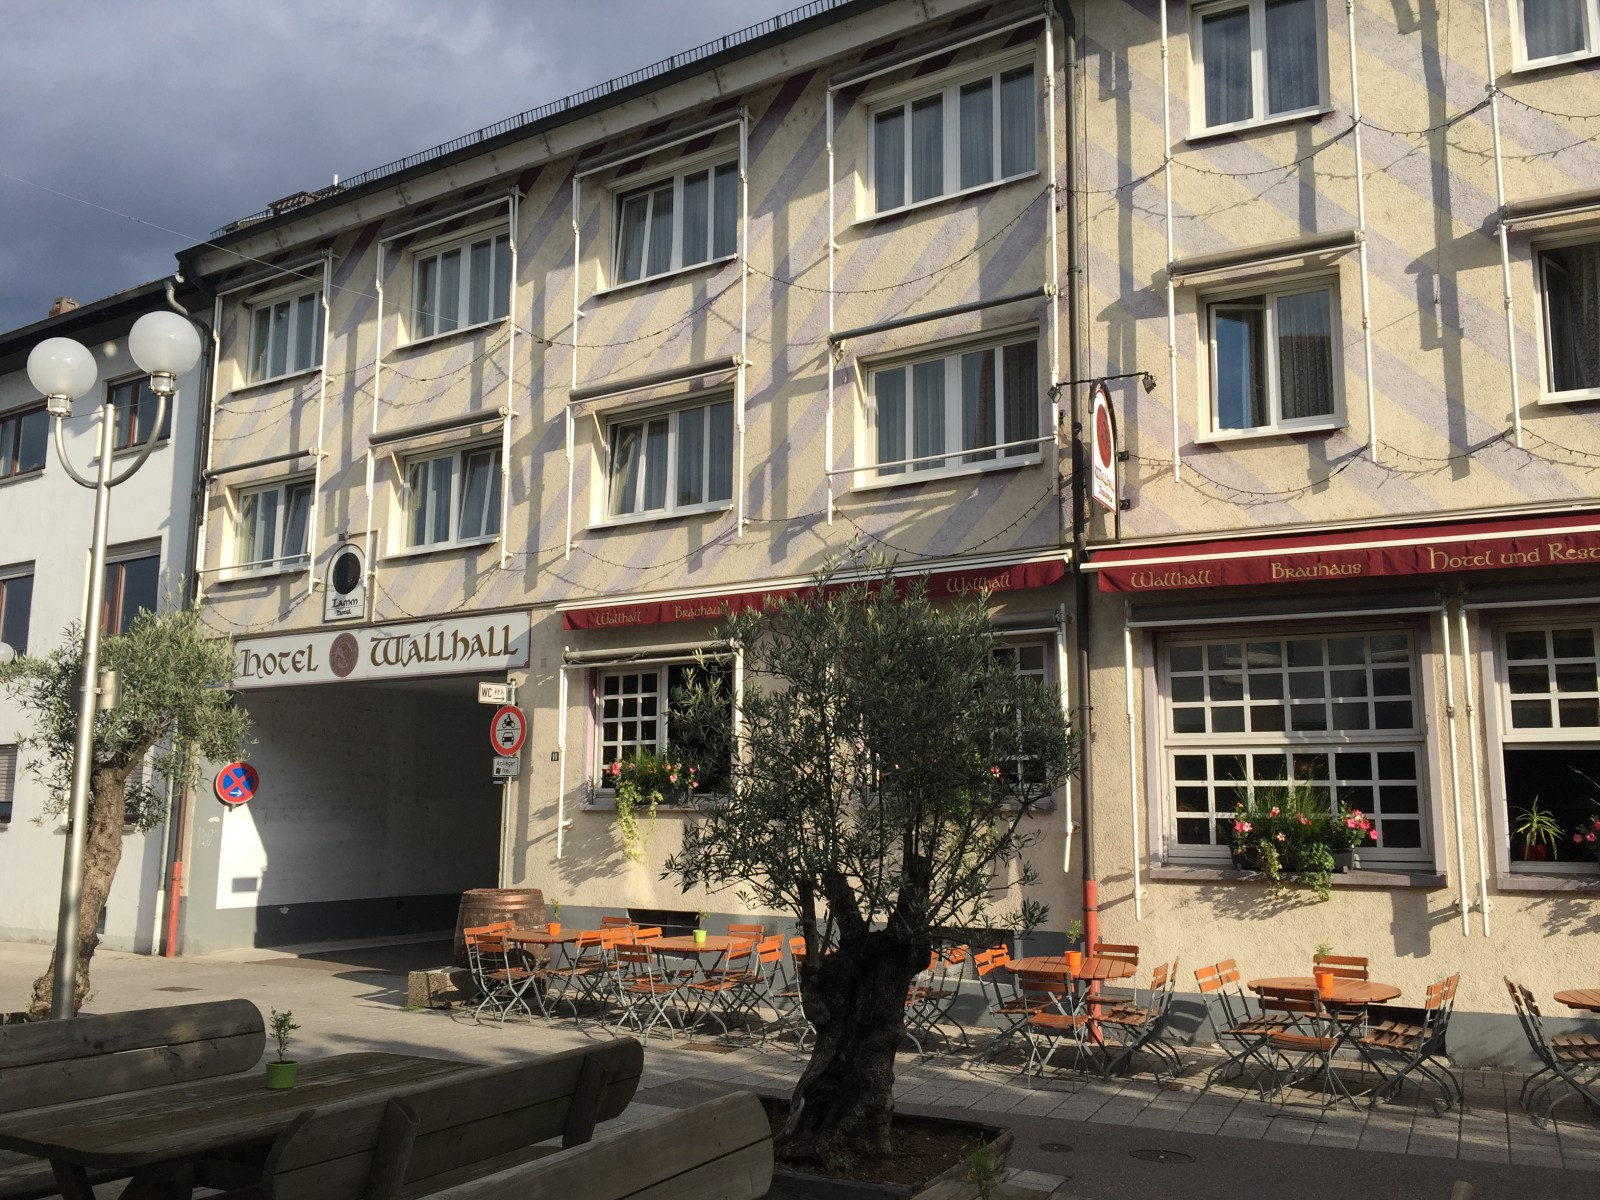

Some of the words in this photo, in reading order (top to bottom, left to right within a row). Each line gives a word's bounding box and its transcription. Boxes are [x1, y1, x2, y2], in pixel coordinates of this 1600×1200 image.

[1130, 570, 1212, 588] Wallhall
[1271, 561, 1362, 579] Brauhaus
[1427, 546, 1494, 570] Hotel
[1500, 548, 1541, 564] und
[596, 611, 641, 626] Wallhall
[675, 604, 725, 619] Brauhau
[946, 575, 1012, 594] Wallhall
[481, 687, 492, 698] WC
